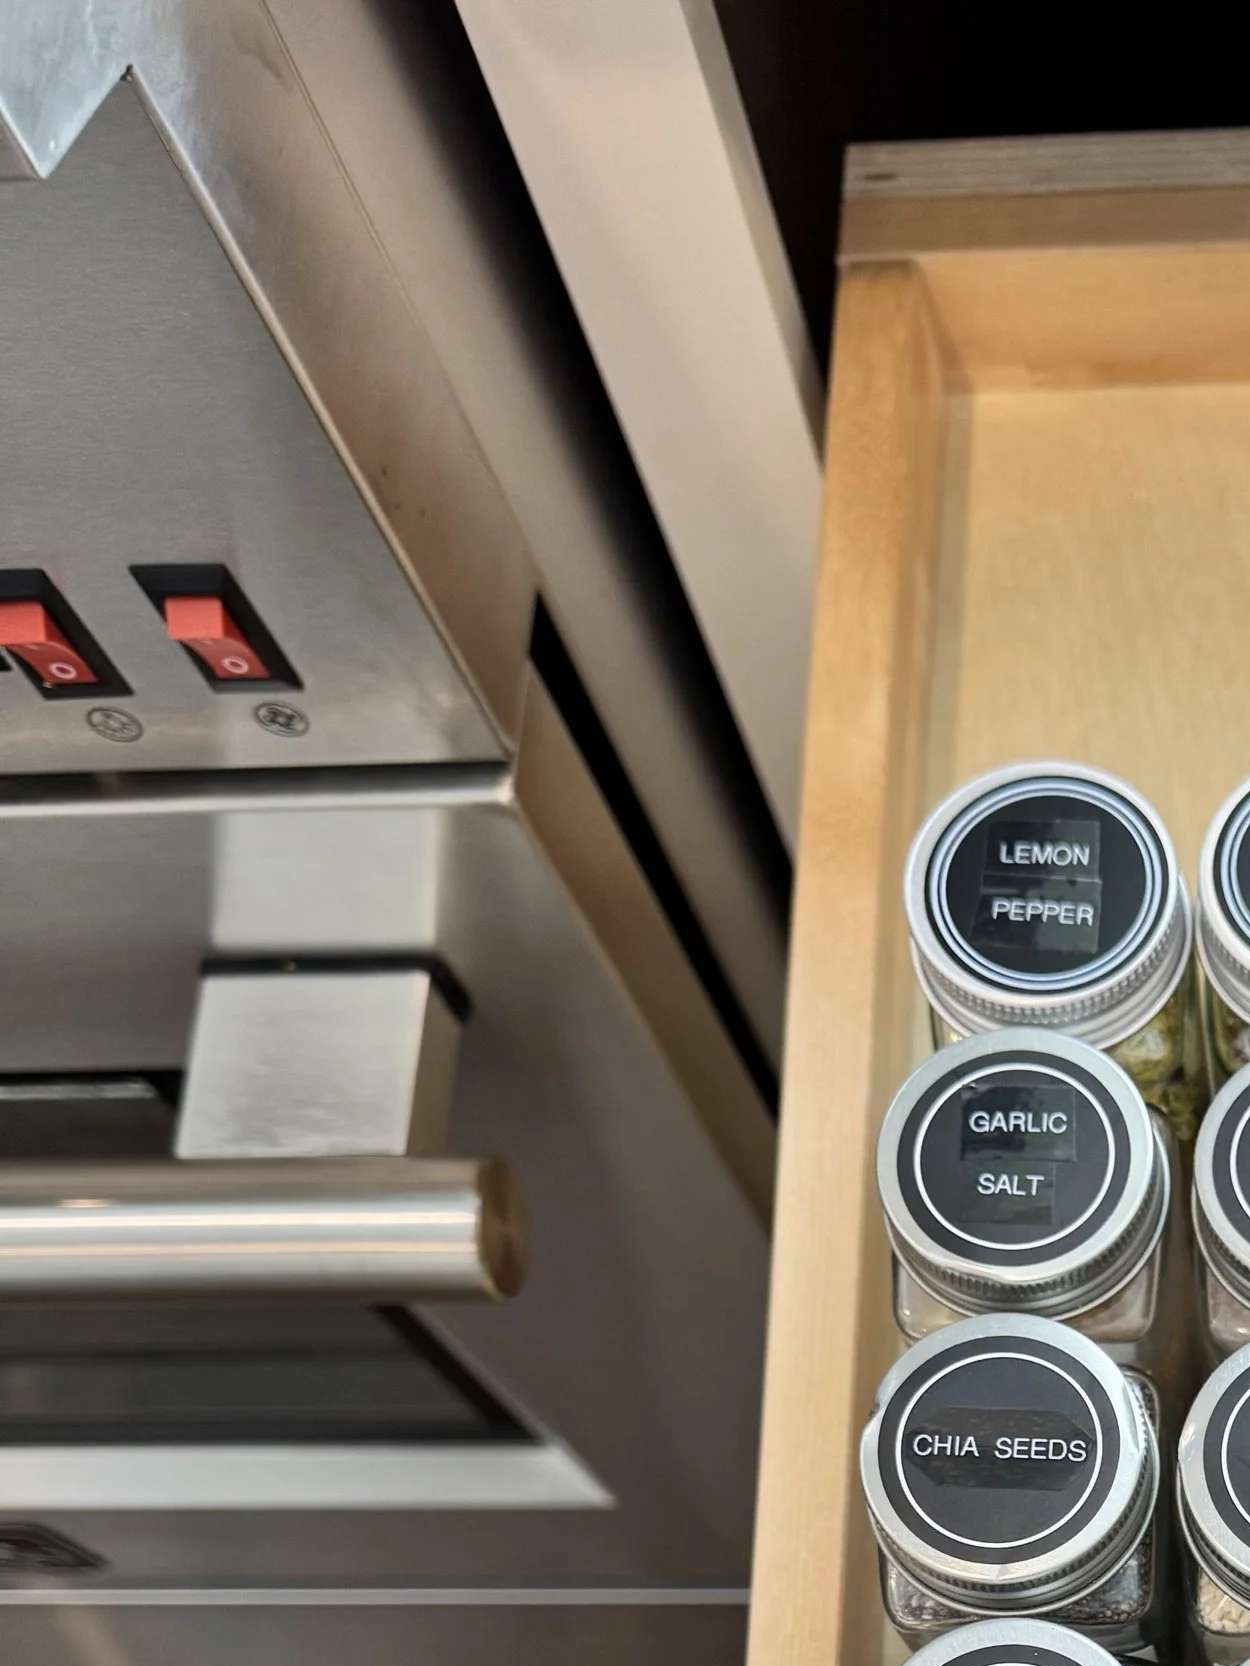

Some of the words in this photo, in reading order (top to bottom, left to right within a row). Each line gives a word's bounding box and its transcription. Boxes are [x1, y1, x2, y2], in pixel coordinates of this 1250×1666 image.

[998, 841, 1092, 868] LEMON
[990, 899, 1095, 927] PEPPER
[967, 1110, 1069, 1135] GARLIC
[976, 1173, 1046, 1198] SALT
[911, 1433, 981, 1460] CHIA
[993, 1435, 1089, 1463] SEEDS
